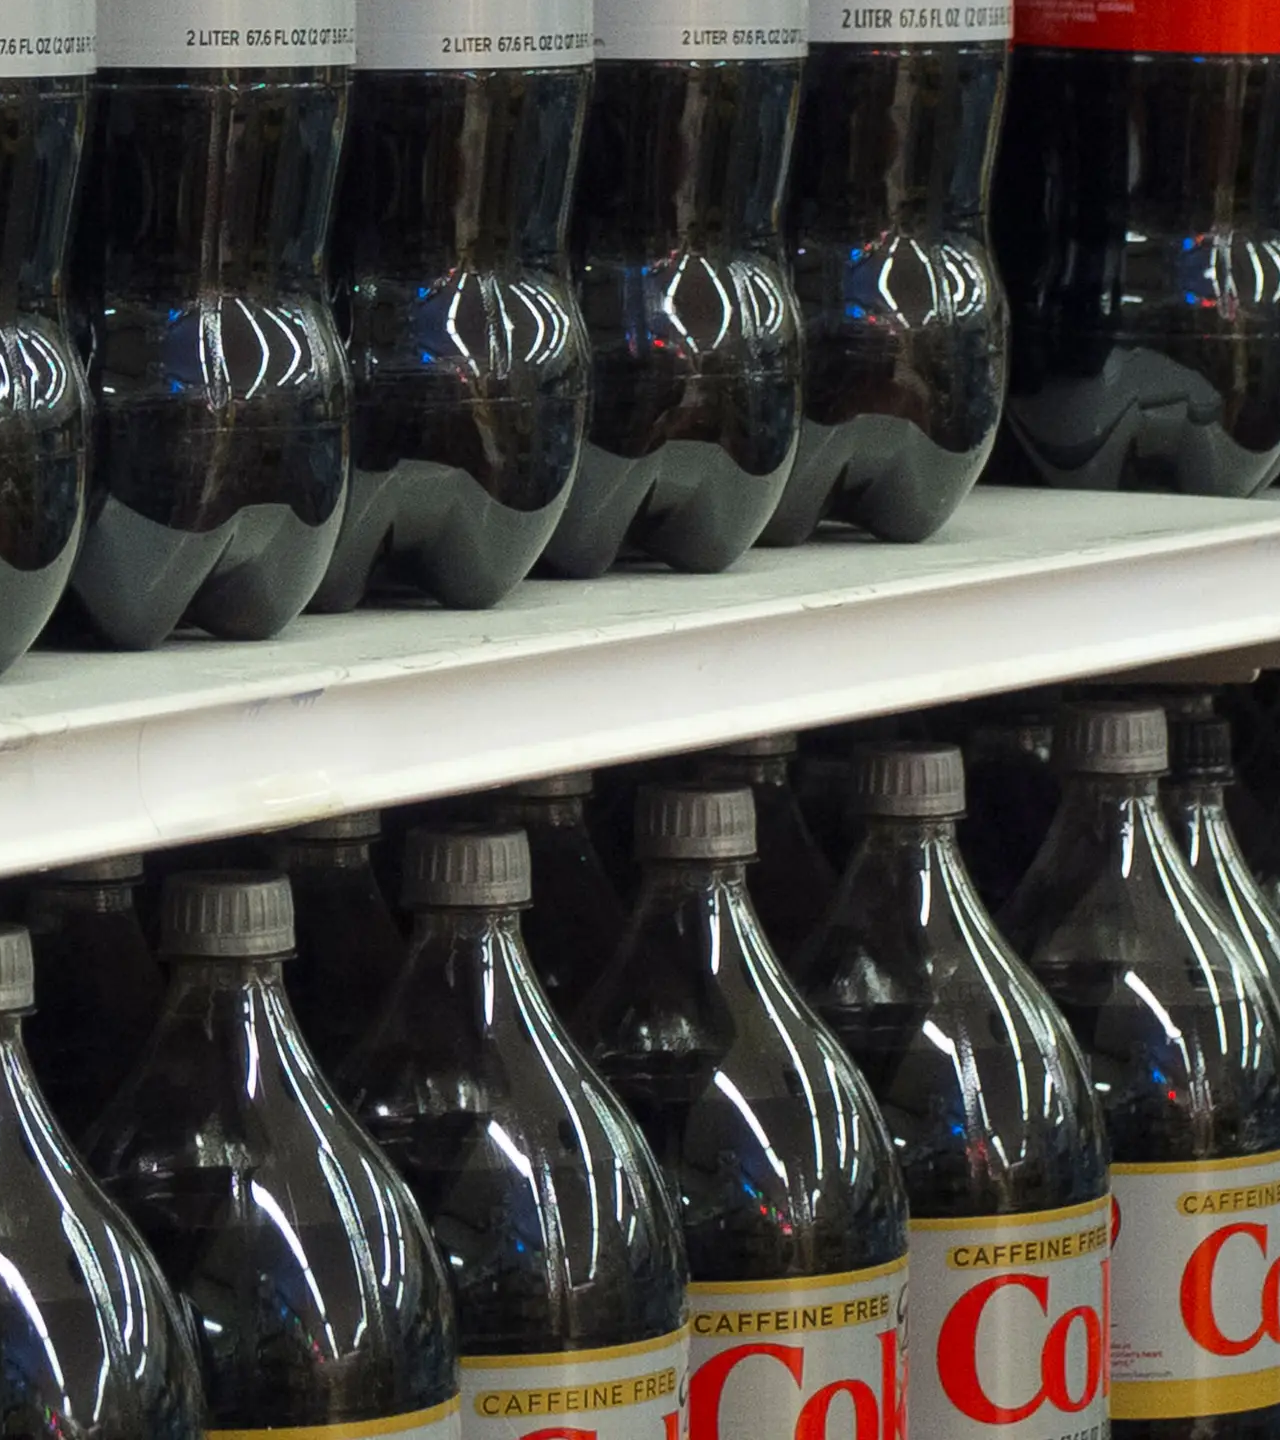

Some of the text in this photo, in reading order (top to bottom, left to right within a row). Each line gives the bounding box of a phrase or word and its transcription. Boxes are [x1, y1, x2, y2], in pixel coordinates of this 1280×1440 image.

[842, 9, 851, 28] 2
[854, 9, 892, 29] LITER
[899, 9, 927, 29] 67.6
[931, 8, 943, 28] FL
[945, 8, 960, 28] OZ
[19, 38, 33, 55] FL
[36, 37, 51, 55] OZ
[187, 30, 196, 46] 2
[199, 30, 240, 46] LITER
[246, 29, 271, 46] 67.6
[274, 29, 288, 46] FL
[291, 29, 306, 45] OZ
[442, 37, 451, 53] 2
[454, 37, 492, 52] LITER
[498, 35, 521, 52] 67.6
[524, 35, 536, 51] FL
[539, 34, 552, 51] OZ
[682, 30, 690, 45] 2
[694, 30, 727, 45] LITER
[733, 30, 753, 46] 67.6
[755, 30, 766, 45] FL
[953, 1236, 1073, 1267] CAFFEINE
[693, 1293, 890, 1334] CAFFEINE FREE
[481, 1369, 677, 1416] CAFFEINE FREE
